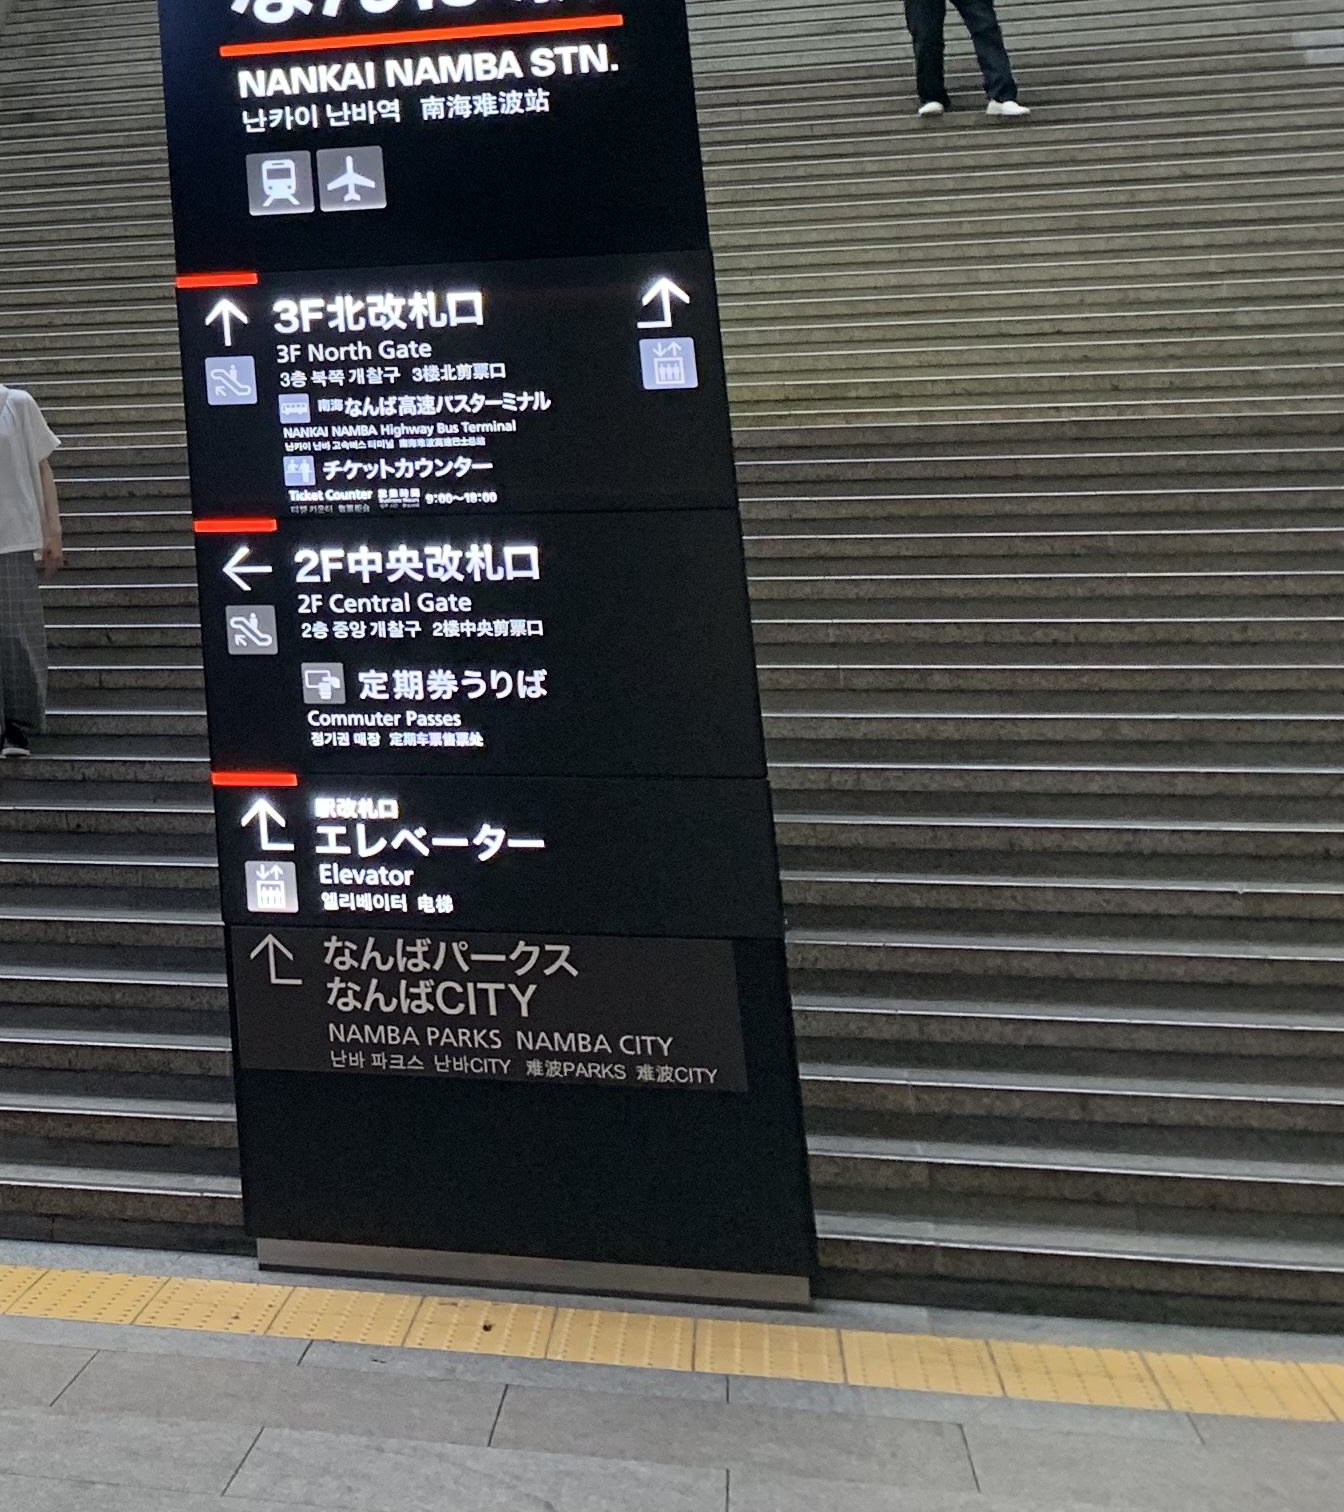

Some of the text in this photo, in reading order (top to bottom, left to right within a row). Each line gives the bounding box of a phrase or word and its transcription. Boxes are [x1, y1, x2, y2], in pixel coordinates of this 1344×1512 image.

[238, 44, 620, 98] NANKAI NAMBA STN.
[241, 98, 402, 134] 난카이 난바역
[420, 88, 551, 121] 南海难波站
[272, 290, 485, 334] 3F北改札口
[276, 339, 432, 363] 3F North Gate
[279, 366, 402, 389] 3층 북쪽 개찰구
[317, 391, 552, 418] 南海なんば高速バスターミナル
[283, 419, 516, 439] NANKAI NAMBA Highway Bus Terminal
[322, 455, 493, 481] チケットカウンター
[288, 488, 373, 502] Ticket Counter
[294, 544, 541, 585] 2F中央改札口
[297, 593, 472, 614] 2F Central Gate
[301, 620, 421, 640] 2층 중앙 개찰구
[358, 667, 549, 702] 定期券うりば
[307, 710, 462, 728] Commuter Passes
[310, 731, 350, 748] 정기권
[315, 822, 546, 862] エレベーター
[319, 863, 414, 886] Elevator
[321, 891, 408, 913] 엘리베이터
[417, 893, 455, 914] 电梯
[323, 934, 579, 978] なんばパークス
[326, 976, 538, 1018] なんばCITY
[329, 1023, 673, 1056] NAMBA PARKS NAMBA CITY
[330, 1050, 511, 1075] 난바 파크스 난바CITY
[526, 1059, 718, 1085] 难波PARKS 难波CITY
